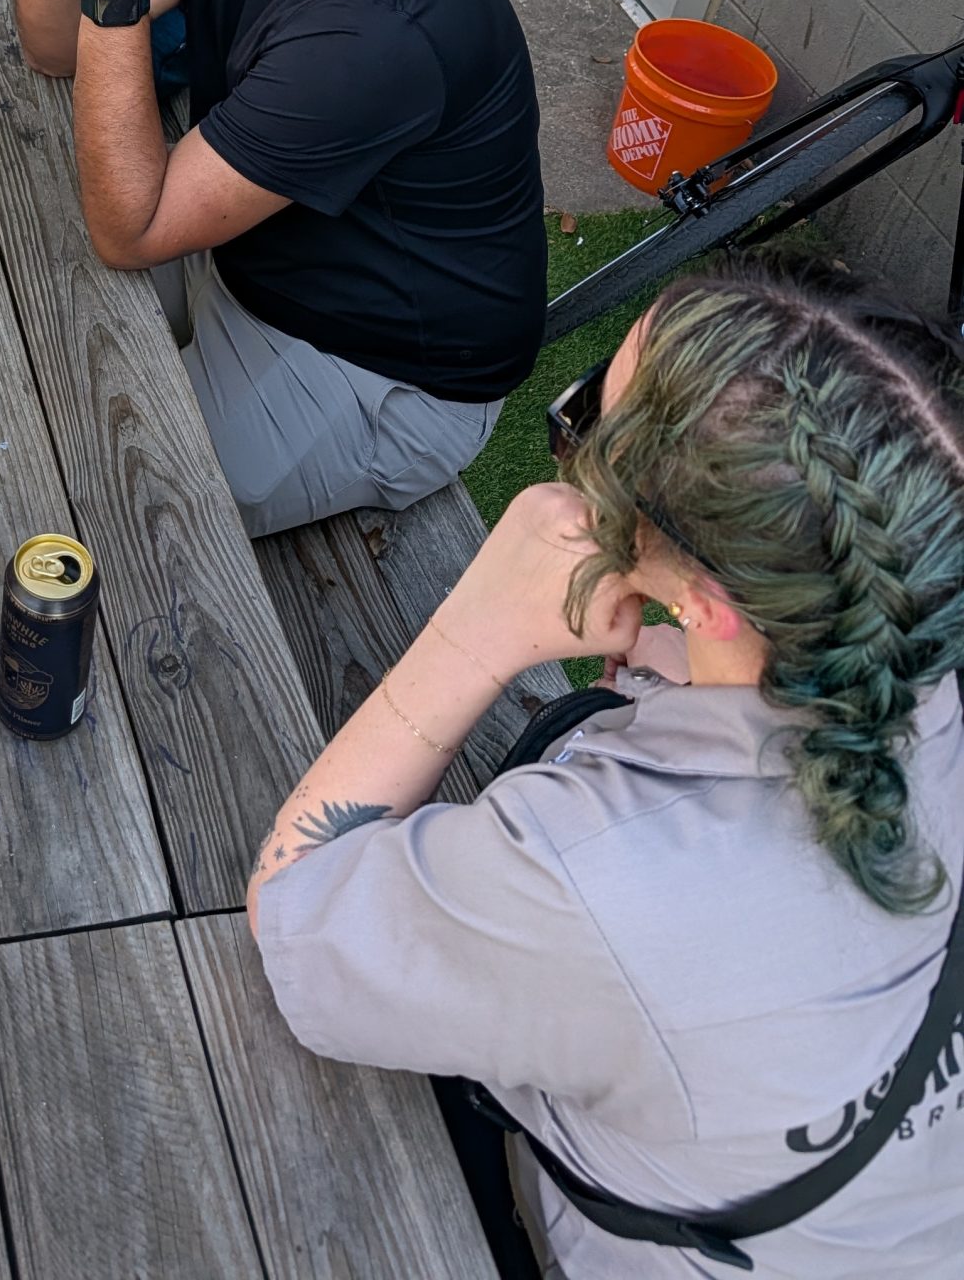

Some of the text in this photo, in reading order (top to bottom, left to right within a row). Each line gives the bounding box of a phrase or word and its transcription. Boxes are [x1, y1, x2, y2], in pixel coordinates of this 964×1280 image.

[622, 108, 639, 123] THE
[612, 117, 668, 150] HOME
[621, 141, 662, 163] DEPOT
